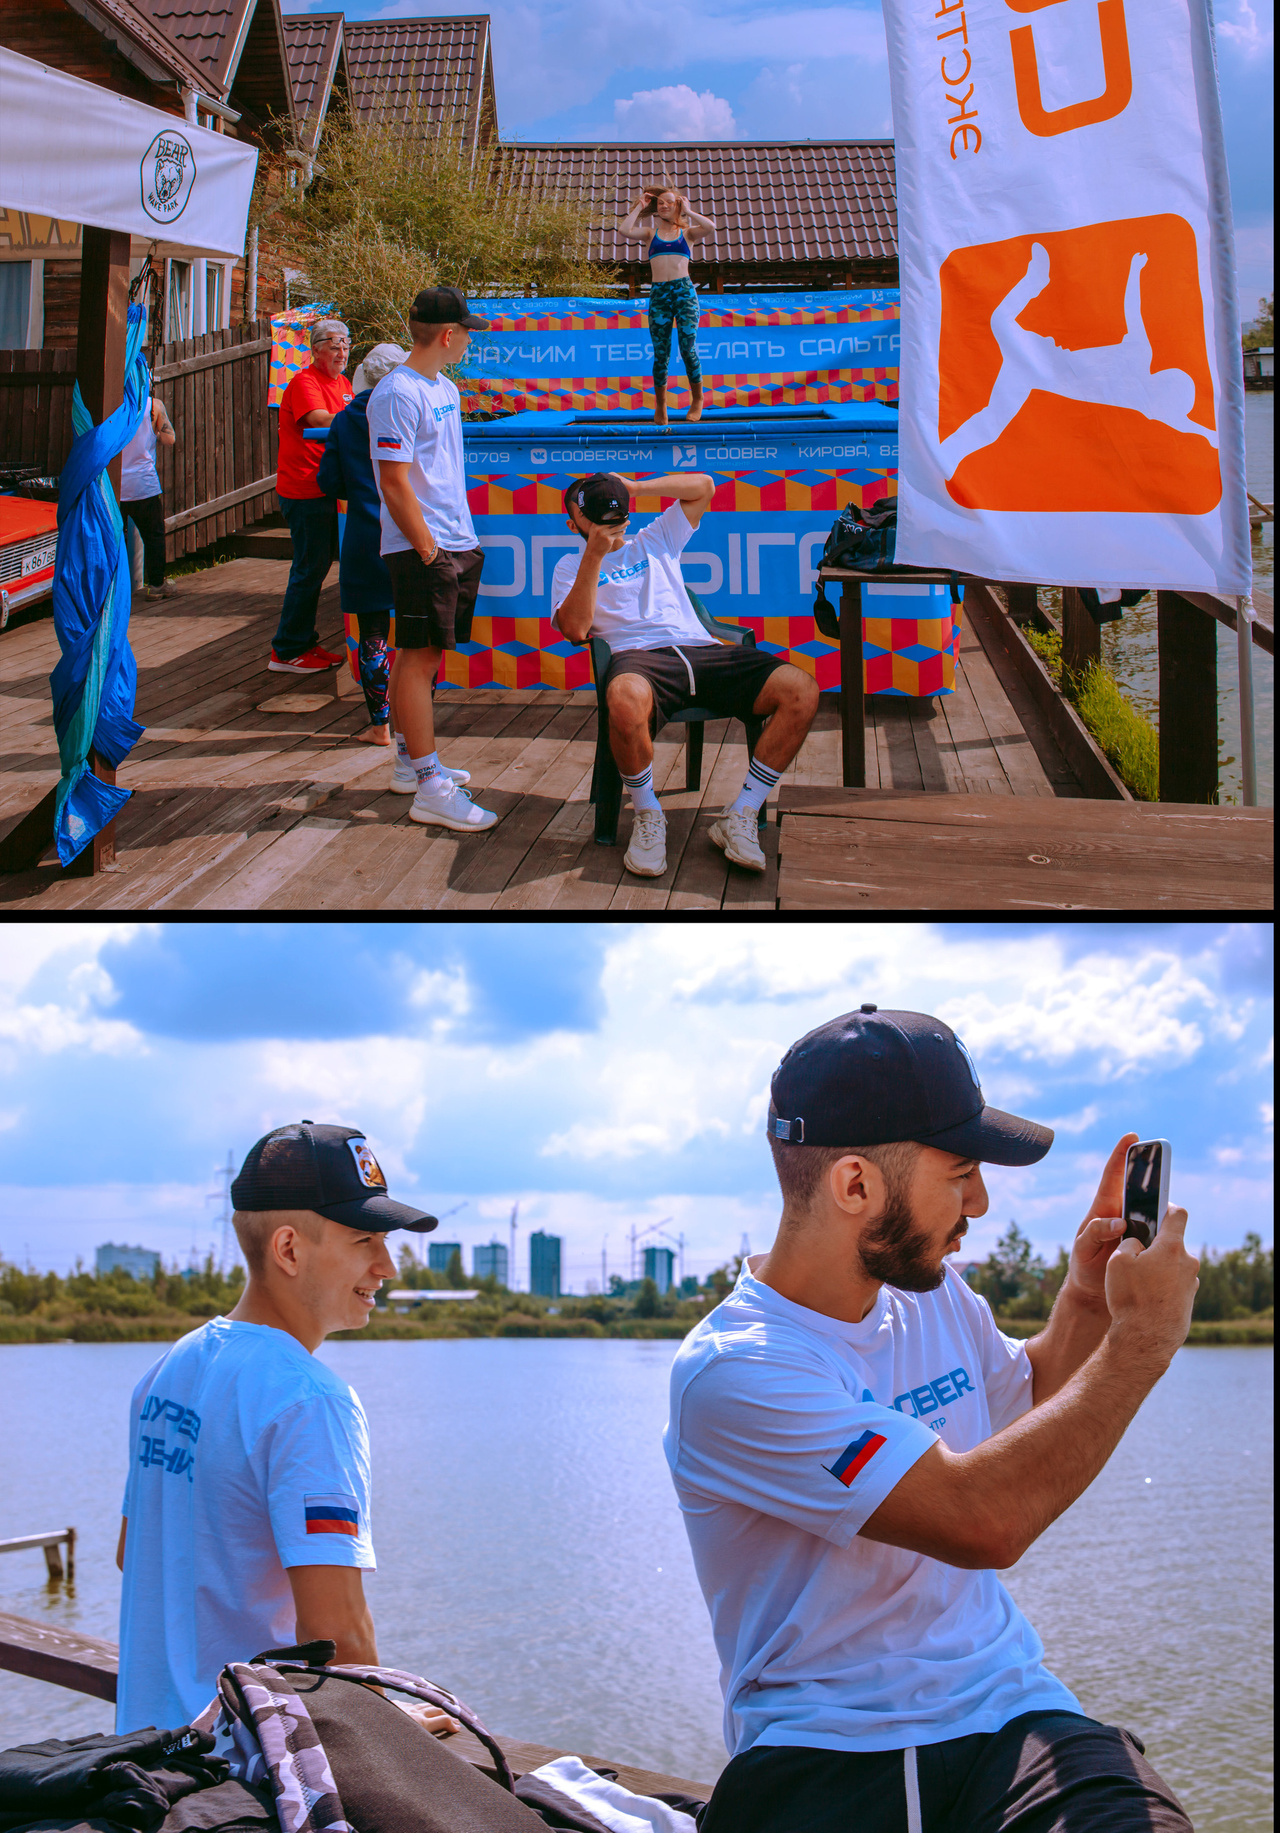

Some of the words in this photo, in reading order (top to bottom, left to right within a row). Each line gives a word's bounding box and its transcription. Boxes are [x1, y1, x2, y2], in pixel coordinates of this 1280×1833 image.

[154, 137, 189, 168] BEAR
[148, 191, 162, 212] WAKE
[163, 199, 179, 212] PARK
[465, 345, 576, 364] НАУЧИМ
[551, 450, 653, 462] COOBERGYM
[705, 447, 778, 460] COOBER
[798, 445, 871, 458] КИРОВА,
